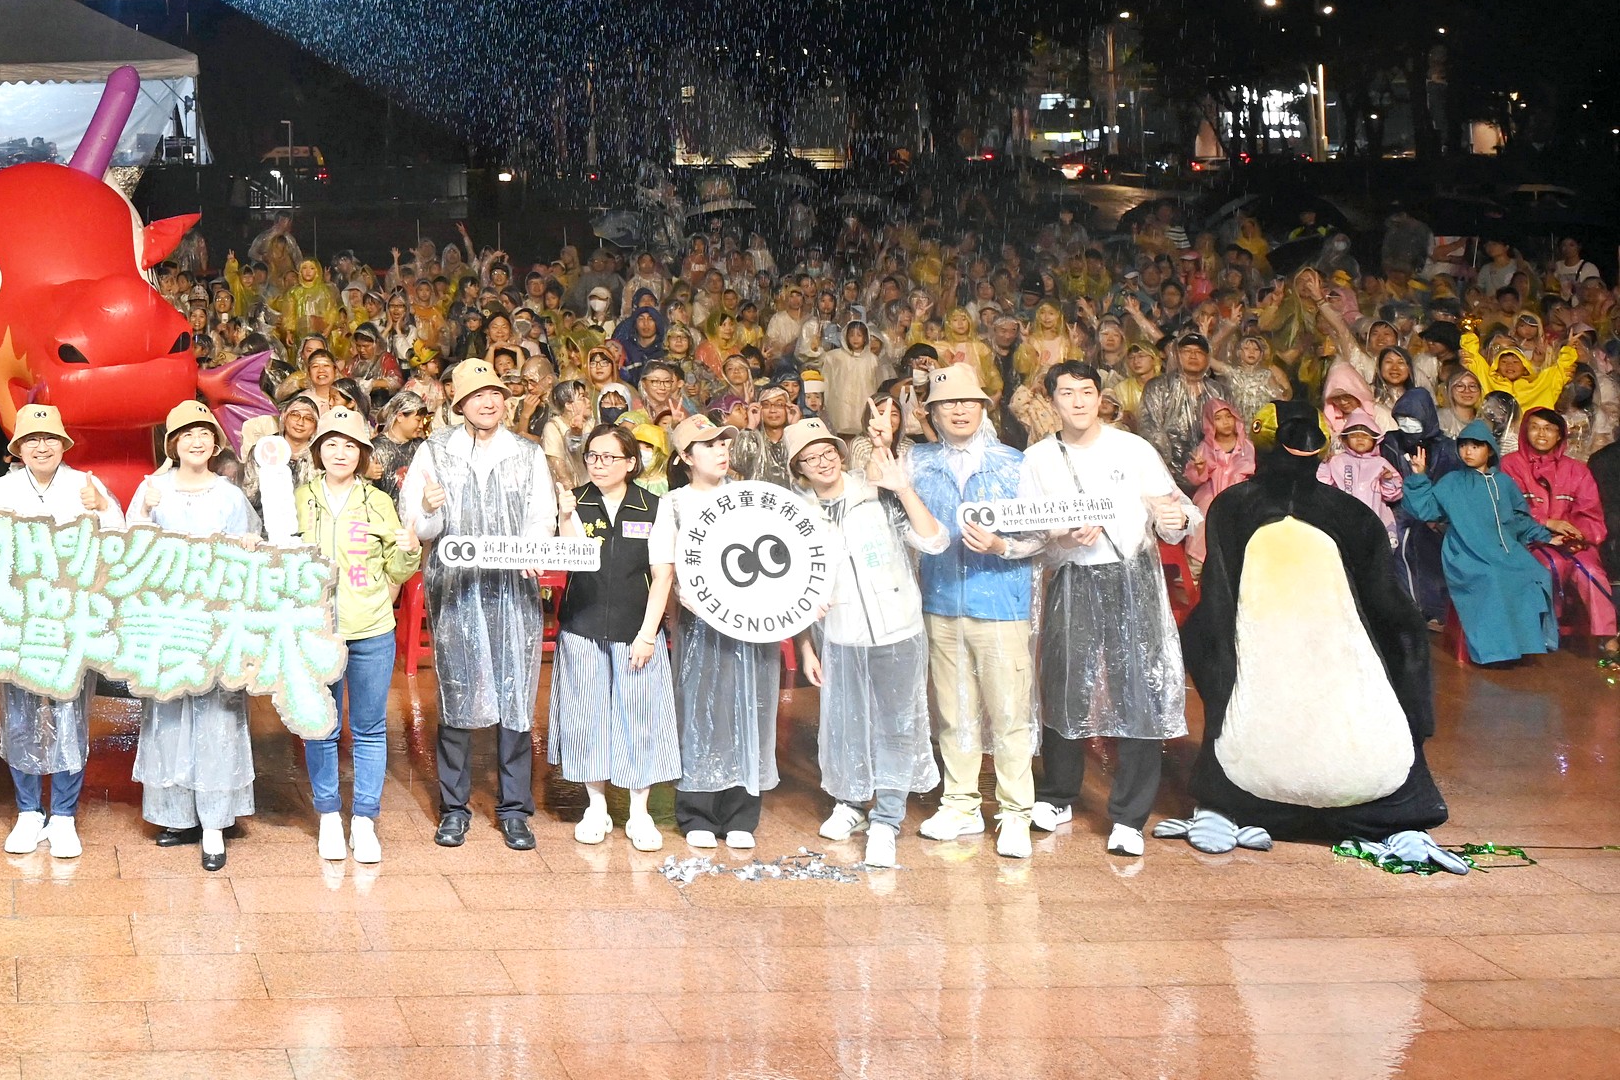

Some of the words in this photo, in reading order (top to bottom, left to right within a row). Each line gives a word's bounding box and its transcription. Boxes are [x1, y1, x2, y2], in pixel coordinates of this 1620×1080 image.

[1002, 518, 1025, 527] NTPC
[1067, 514, 1082, 523] Art
[1083, 512, 1116, 521] Festival
[347, 521, 370, 587] 石一佑
[547, 557, 560, 565] Art
[563, 558, 595, 566] Festival
